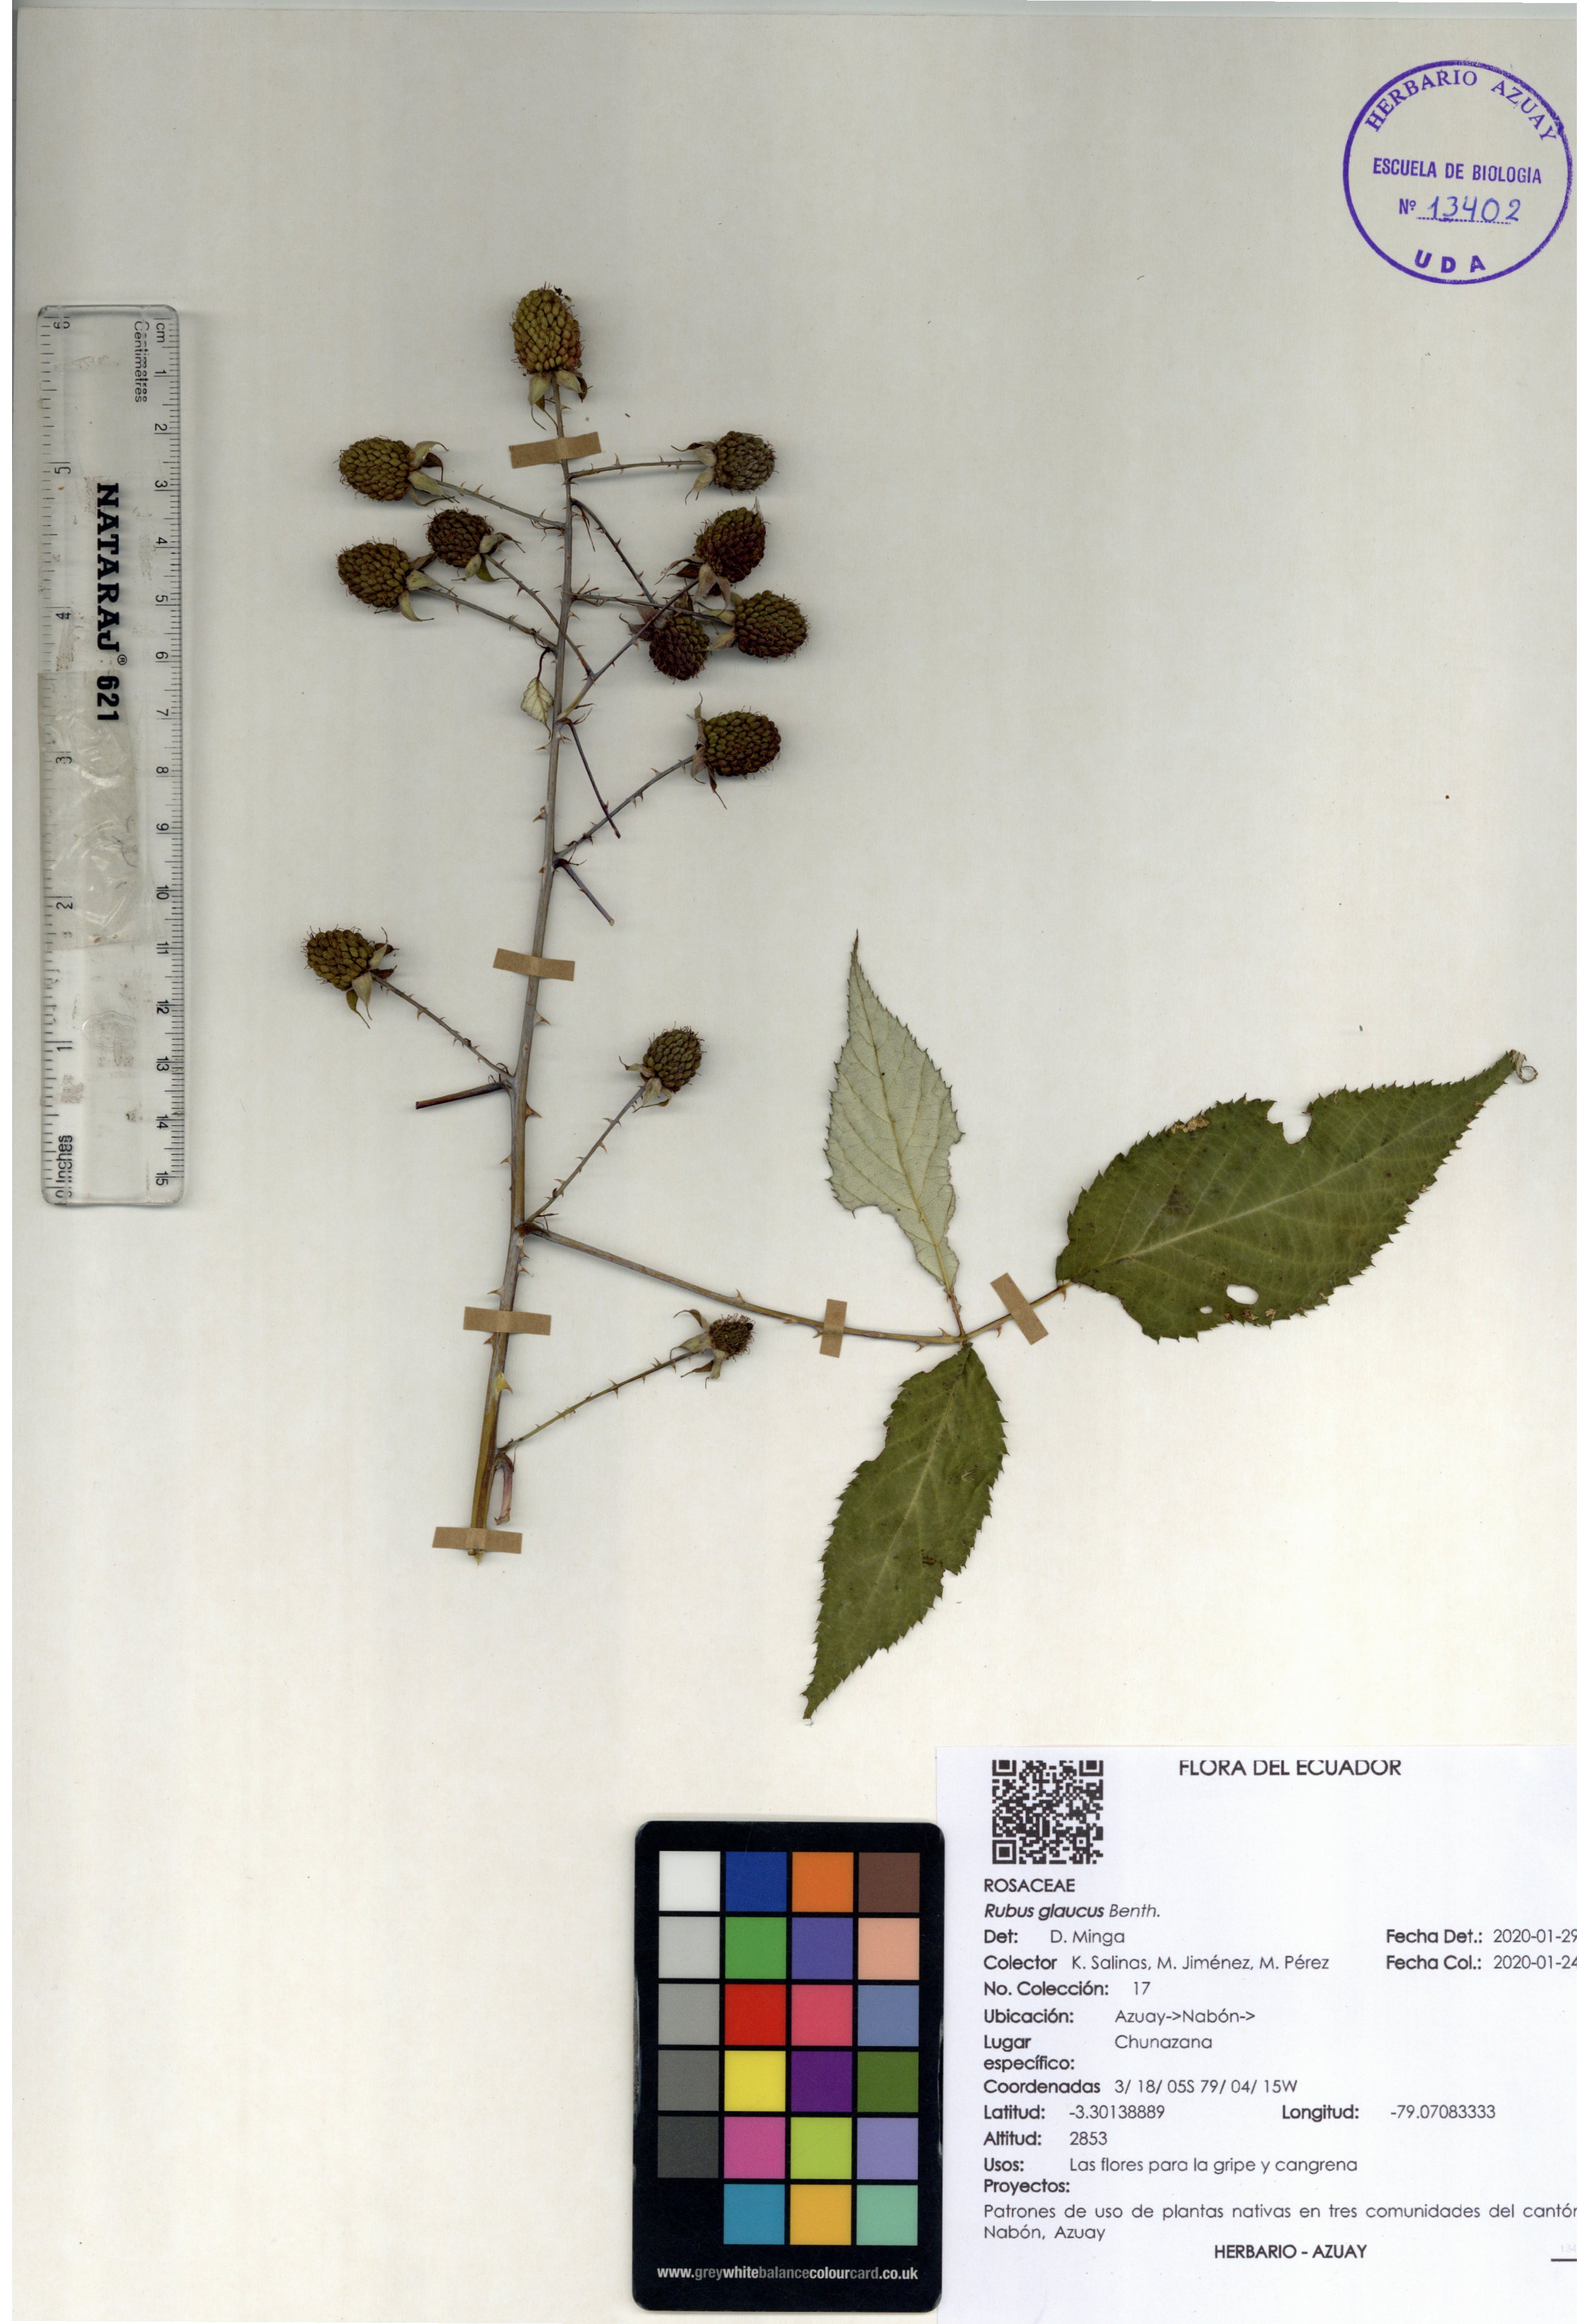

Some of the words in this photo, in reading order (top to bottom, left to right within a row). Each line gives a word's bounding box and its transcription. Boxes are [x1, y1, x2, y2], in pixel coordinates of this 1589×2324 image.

[1365, 69, 1478, 132] HERBARIO
[1491, 80, 1556, 141] AZUAY
[1373, 157, 1437, 177] ESCUELA
[1445, 163, 1464, 179] DE
[1472, 164, 1542, 184] BIOLOGIA
[1427, 196, 1521, 222] 13402
[156, 322, 165, 343] cm
[156, 651, 168, 660] 6
[97, 675, 120, 722] 621
[156, 885, 169, 900] 10
[157, 941, 169, 954] 11
[156, 999, 169, 1014] 12
[156, 1056, 169, 1071] 13
[156, 1114, 168, 1129] 14
[55, 1135, 73, 1182] Inches
[156, 1171, 168, 1186] 15
[1180, 1760, 1246, 1776] FLORA
[1254, 1760, 1290, 1775] DEL
[1297, 1760, 1401, 1775] ECUADOR
[985, 1878, 1075, 1892] ROSACEAE
[985, 1904, 1034, 1918] Rubus
[1039, 1904, 1105, 1921] glaucus
[1109, 1904, 1160, 1917] Benth.
[985, 1929, 1017, 1943] Det:
[1051, 1930, 1066, 1943] D.
[1073, 1929, 1124, 1946] Minga
[1387, 1929, 1438, 1943] Fecha
[1444, 1929, 1482, 1943] Det.:
[984, 1955, 1057, 1970] Colector
[1072, 1956, 1085, 1969] K.
[1091, 1956, 1151, 1971] Salinas,
[1158, 1956, 1176, 1970] M.
[1183, 1955, 1253, 1971] Jiménez,
[1260, 1956, 1278, 1970] M.
[1286, 1955, 1329, 1970] Pérez
[1387, 1955, 1438, 1970] Fecha
[1444, 1955, 1481, 1970] Col.:
[985, 1981, 1012, 1995] No.
[1017, 1981, 1108, 1996] Colección:
[1134, 1982, 1150, 1995] 17
[985, 2008, 1073, 2024] Ubicación:
[1115, 2008, 1255, 2025] Azuay->Nabón->
[985, 2035, 1031, 2052] Lugar
[1115, 2035, 1212, 2048] Chunazana
[984, 2055, 1074, 2073] específico:
[984, 2079, 1100, 2093] Coordenadas
[1115, 2080, 1131, 2094] 3/
[1139, 2080, 1162, 2094] 18/
[1168, 2080, 1194, 2093] 05S
[1201, 2080, 1226, 2094] 79/
[1232, 2080, 1257, 2094] 04/
[1264, 2080, 1297, 2093] 15W
[985, 2105, 1045, 2119] Latitud:
[1069, 2105, 1164, 2119] -3.30138889
[1283, 2104, 1359, 2122] Longitud:
[1391, 2105, 1495, 2118] -79.07083333
[983, 2131, 1041, 2145] Altitud:
[1070, 2131, 1107, 2145] 2853
[984, 2157, 1024, 2171] Usos:
[1071, 2159, 1095, 2171] Las
[1101, 2157, 1143, 2171] flores
[1149, 2161, 1188, 2174] para
[1194, 2158, 1207, 2171] la
[1214, 2158, 1255, 2174] gripe
[1261, 2162, 1270, 2174] y
[1275, 2161, 1357, 2174] cangrena
[985, 2179, 1069, 2196] Proyectos:
[985, 2204, 1055, 2218] Patrones
[1065, 2205, 1086, 2218] de
[1095, 2208, 1123, 2218] uso
[1132, 2205, 1154, 2218] de
[1163, 2205, 1223, 2220] plantas
[1233, 2204, 1290, 2217] nativas
[1300, 2208, 1320, 2217] en
[1329, 2204, 1356, 2217] tres
[1366, 2204, 1480, 2217] comunidades
[1490, 2204, 1514, 2217] del
[985, 2225, 1045, 2240] Nabón,
[1054, 2226, 1105, 2241] Azuay
[1215, 2245, 1297, 2259] HERBARIO
[1312, 2245, 1367, 2259] AZUAY
[657, 2266, 918, 2280] www.greywhitebalancecolourcard.co.uk
